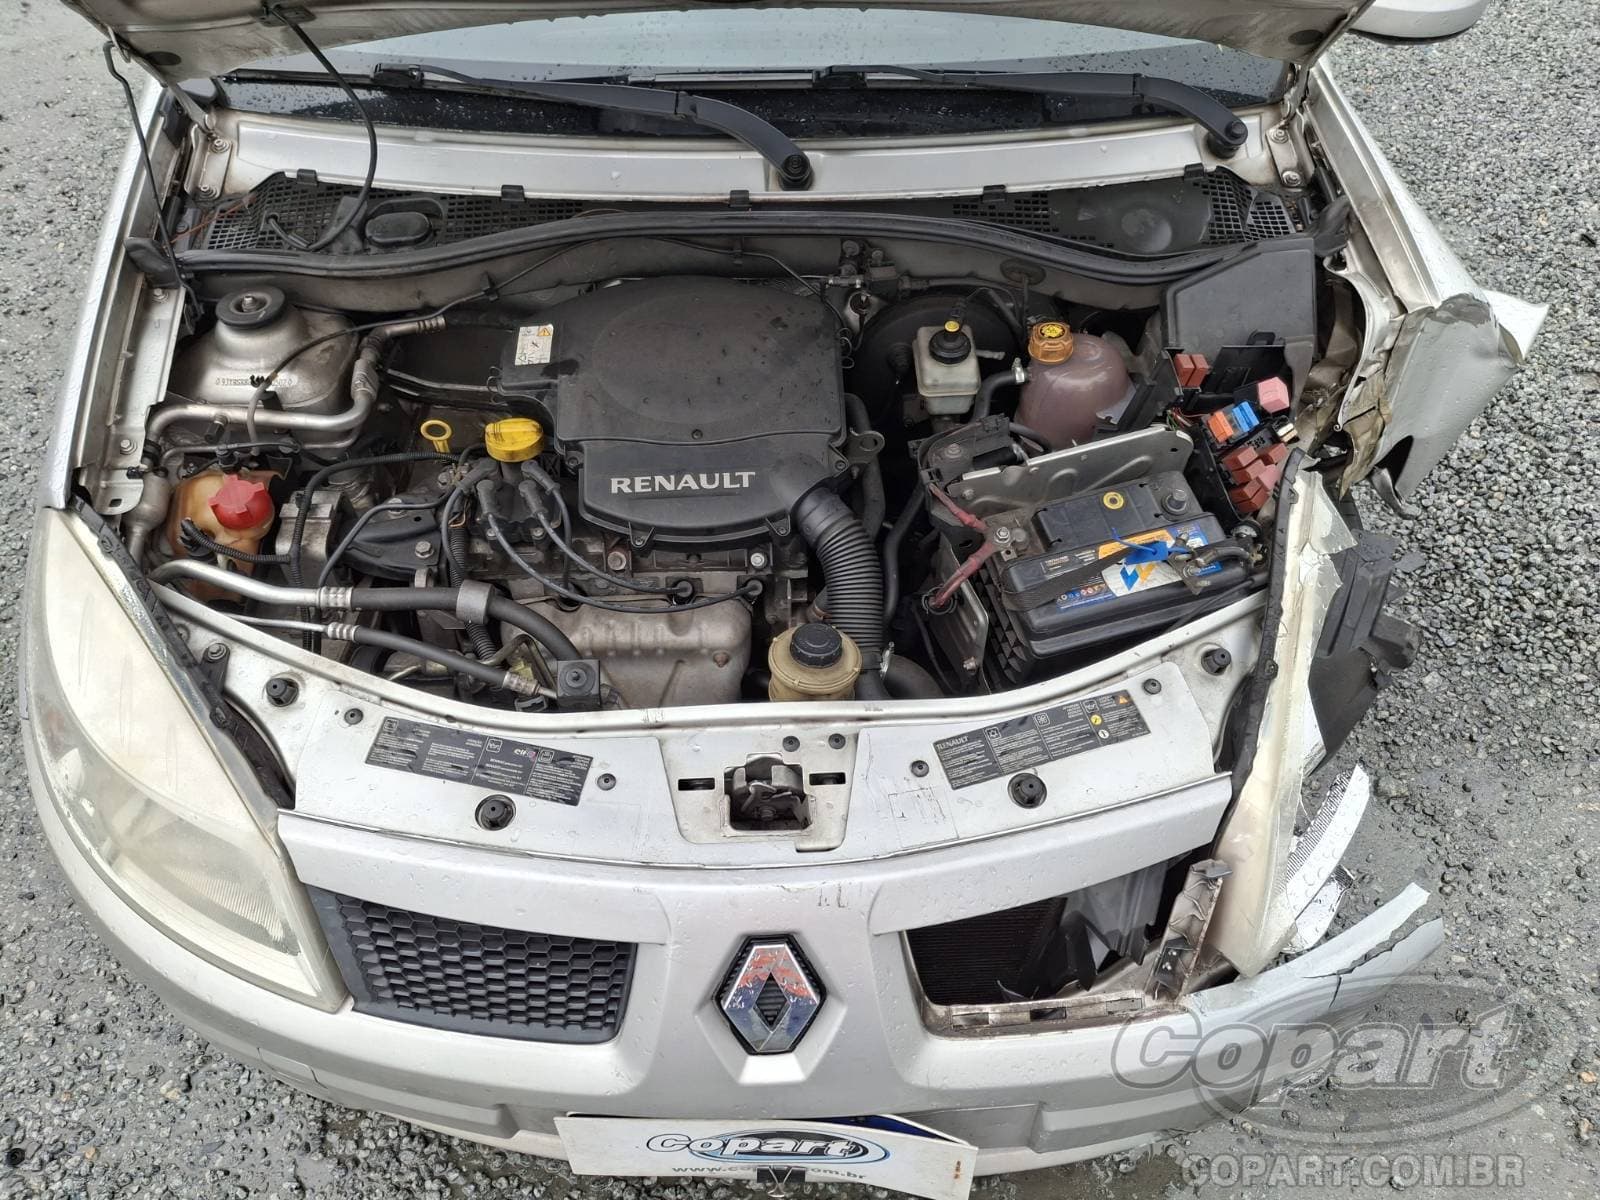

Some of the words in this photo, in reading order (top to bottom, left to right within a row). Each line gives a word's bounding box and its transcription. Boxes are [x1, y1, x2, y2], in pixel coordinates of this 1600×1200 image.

[610, 471, 756, 494] RENAULT
[646, 1133, 857, 1158] Copart
[672, 1167, 867, 1179] www.coom.br
